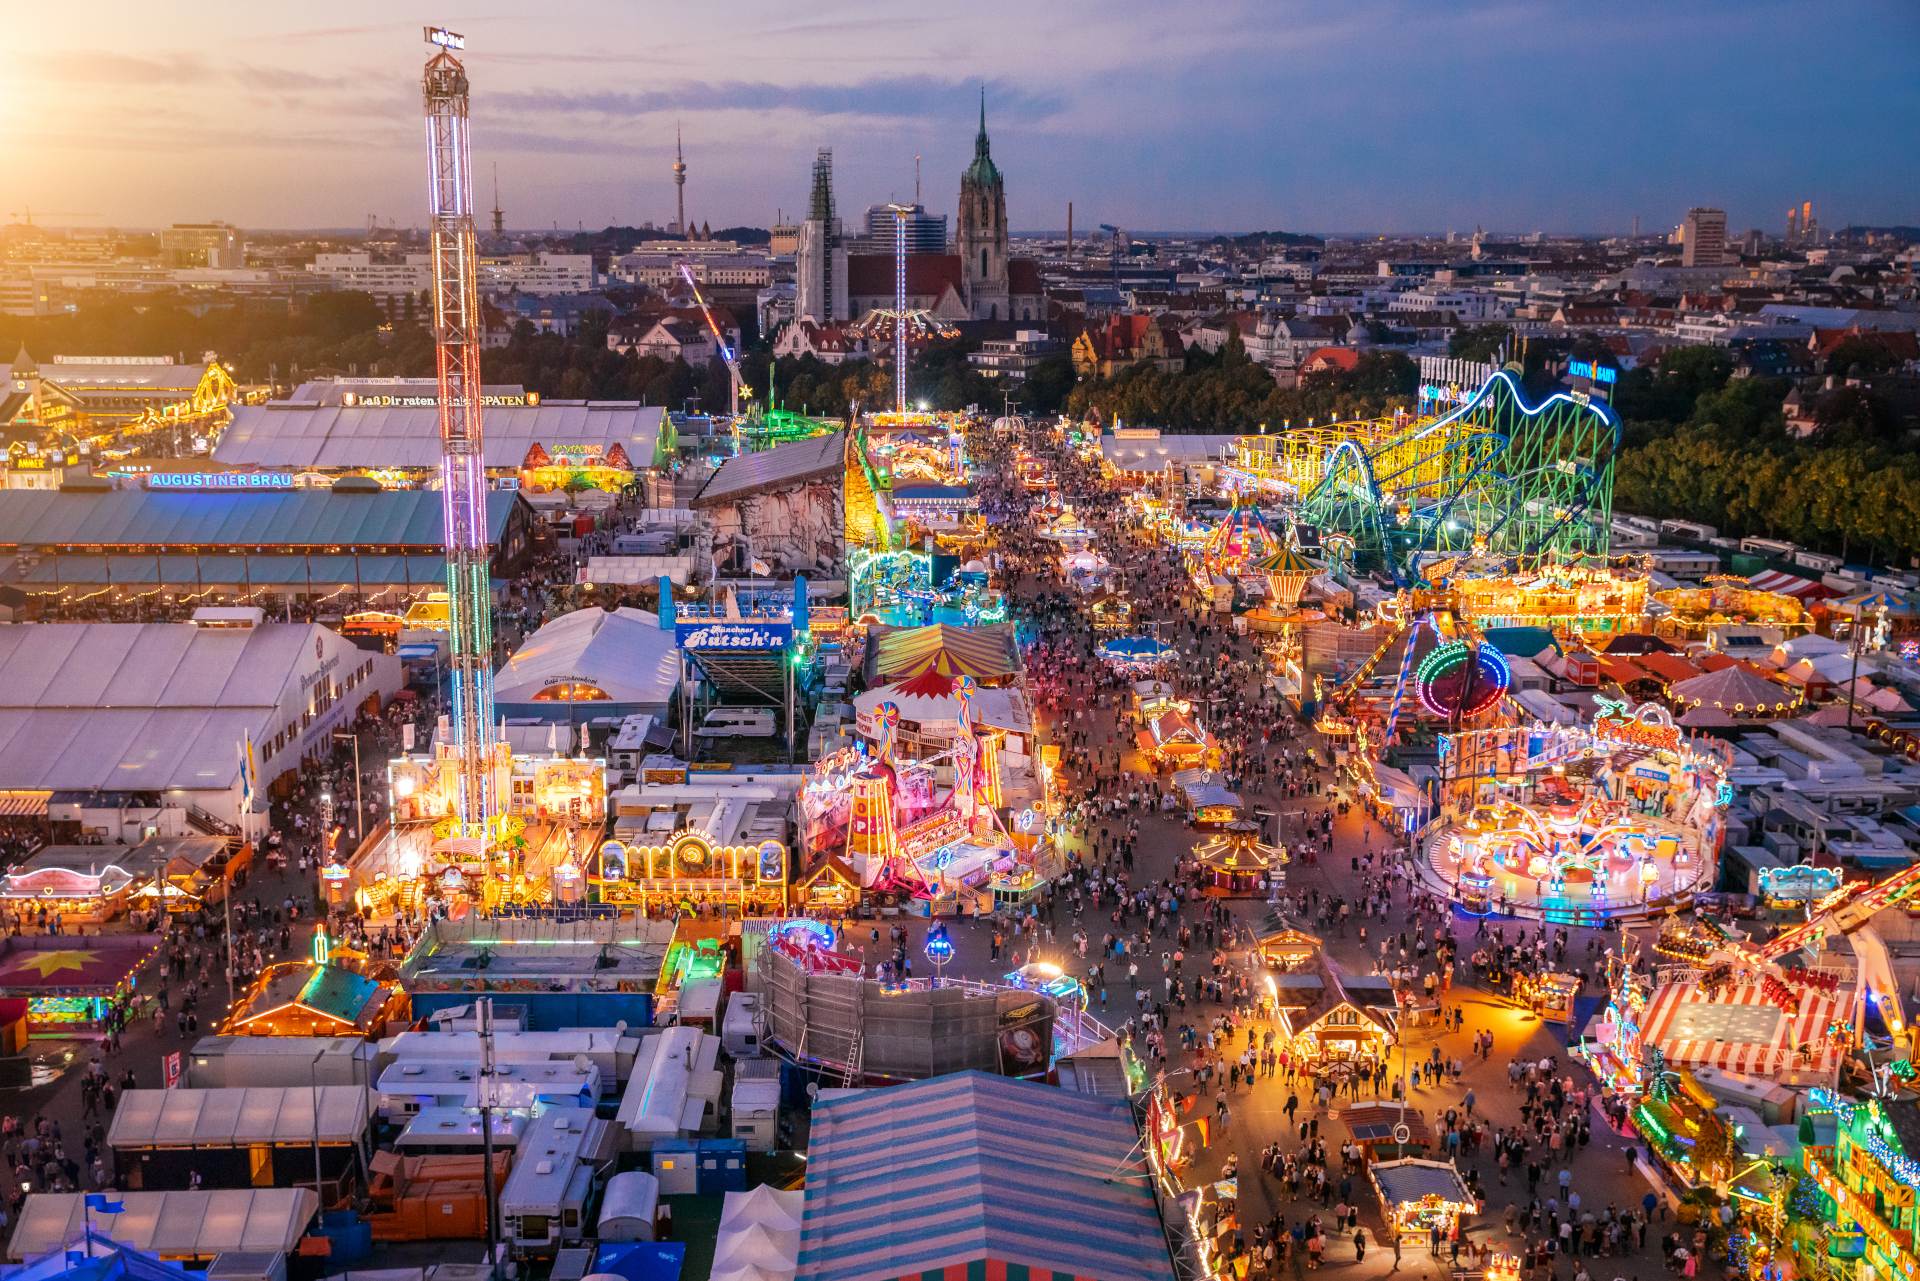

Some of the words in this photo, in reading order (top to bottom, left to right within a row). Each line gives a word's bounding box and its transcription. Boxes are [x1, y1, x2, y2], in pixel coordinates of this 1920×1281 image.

[381, 395, 402, 406] Dir
[479, 395, 525, 406] SPATEN
[151, 474, 248, 486] AUGUSTINER
